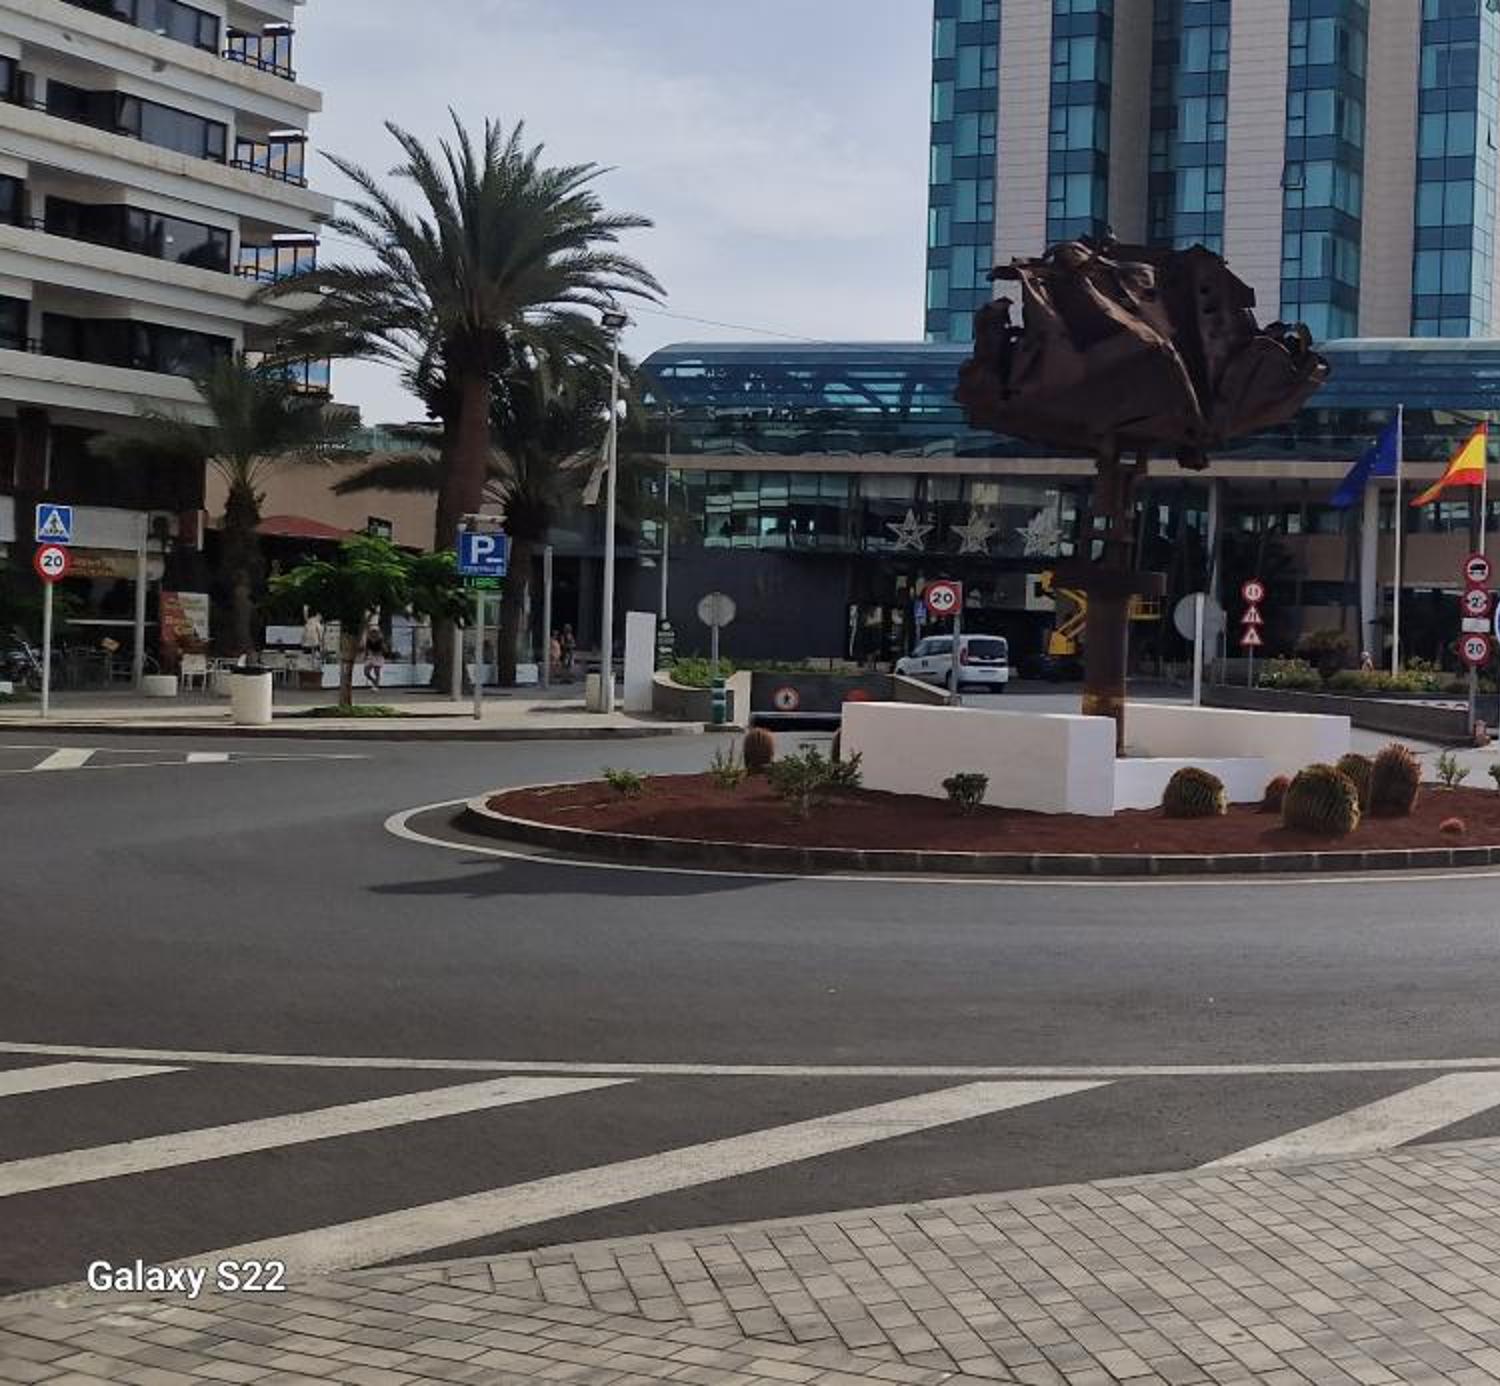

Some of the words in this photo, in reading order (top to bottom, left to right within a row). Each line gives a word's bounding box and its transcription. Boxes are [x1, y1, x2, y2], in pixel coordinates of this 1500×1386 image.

[470, 535, 495, 565] P
[43, 555, 63, 567] 20
[932, 591, 953, 604] 20
[1467, 643, 1484, 655] 20
